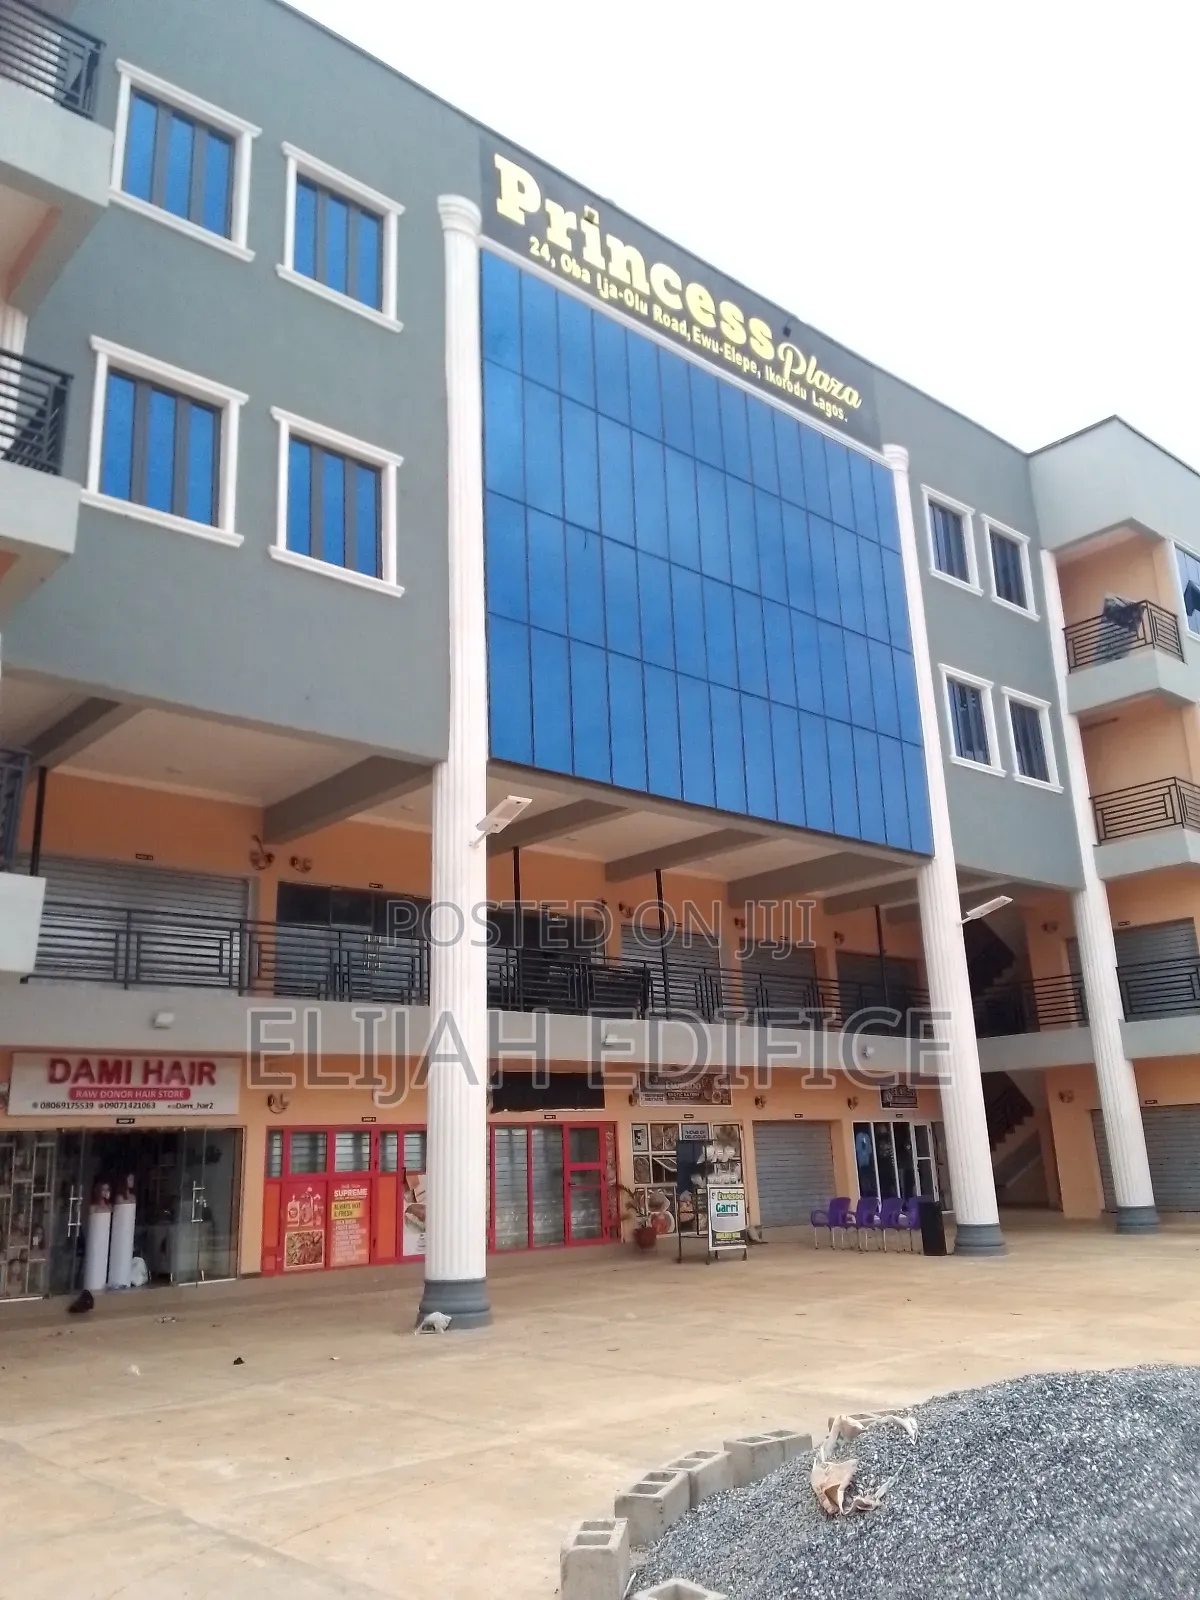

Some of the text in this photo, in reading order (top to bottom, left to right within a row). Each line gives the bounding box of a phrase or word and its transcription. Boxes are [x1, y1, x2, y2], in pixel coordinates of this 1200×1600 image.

[494, 153, 776, 361] Princess
[529, 235, 556, 270] 24,
[560, 251, 591, 285] Oba
[652, 304, 692, 341] Road,
[692, 326, 762, 379] Ewu-Elepe,
[764, 364, 808, 401] Ikorodu
[812, 389, 849, 423] Lagos.
[778, 342, 863, 409] Plaza
[48, 1057, 216, 1086] DAMI HAIR
[75, 1090, 184, 1099] RAW DONOR HAIR STORE
[334, 1188, 368, 1197] SUPREME
[716, 1202, 739, 1212] Garri
